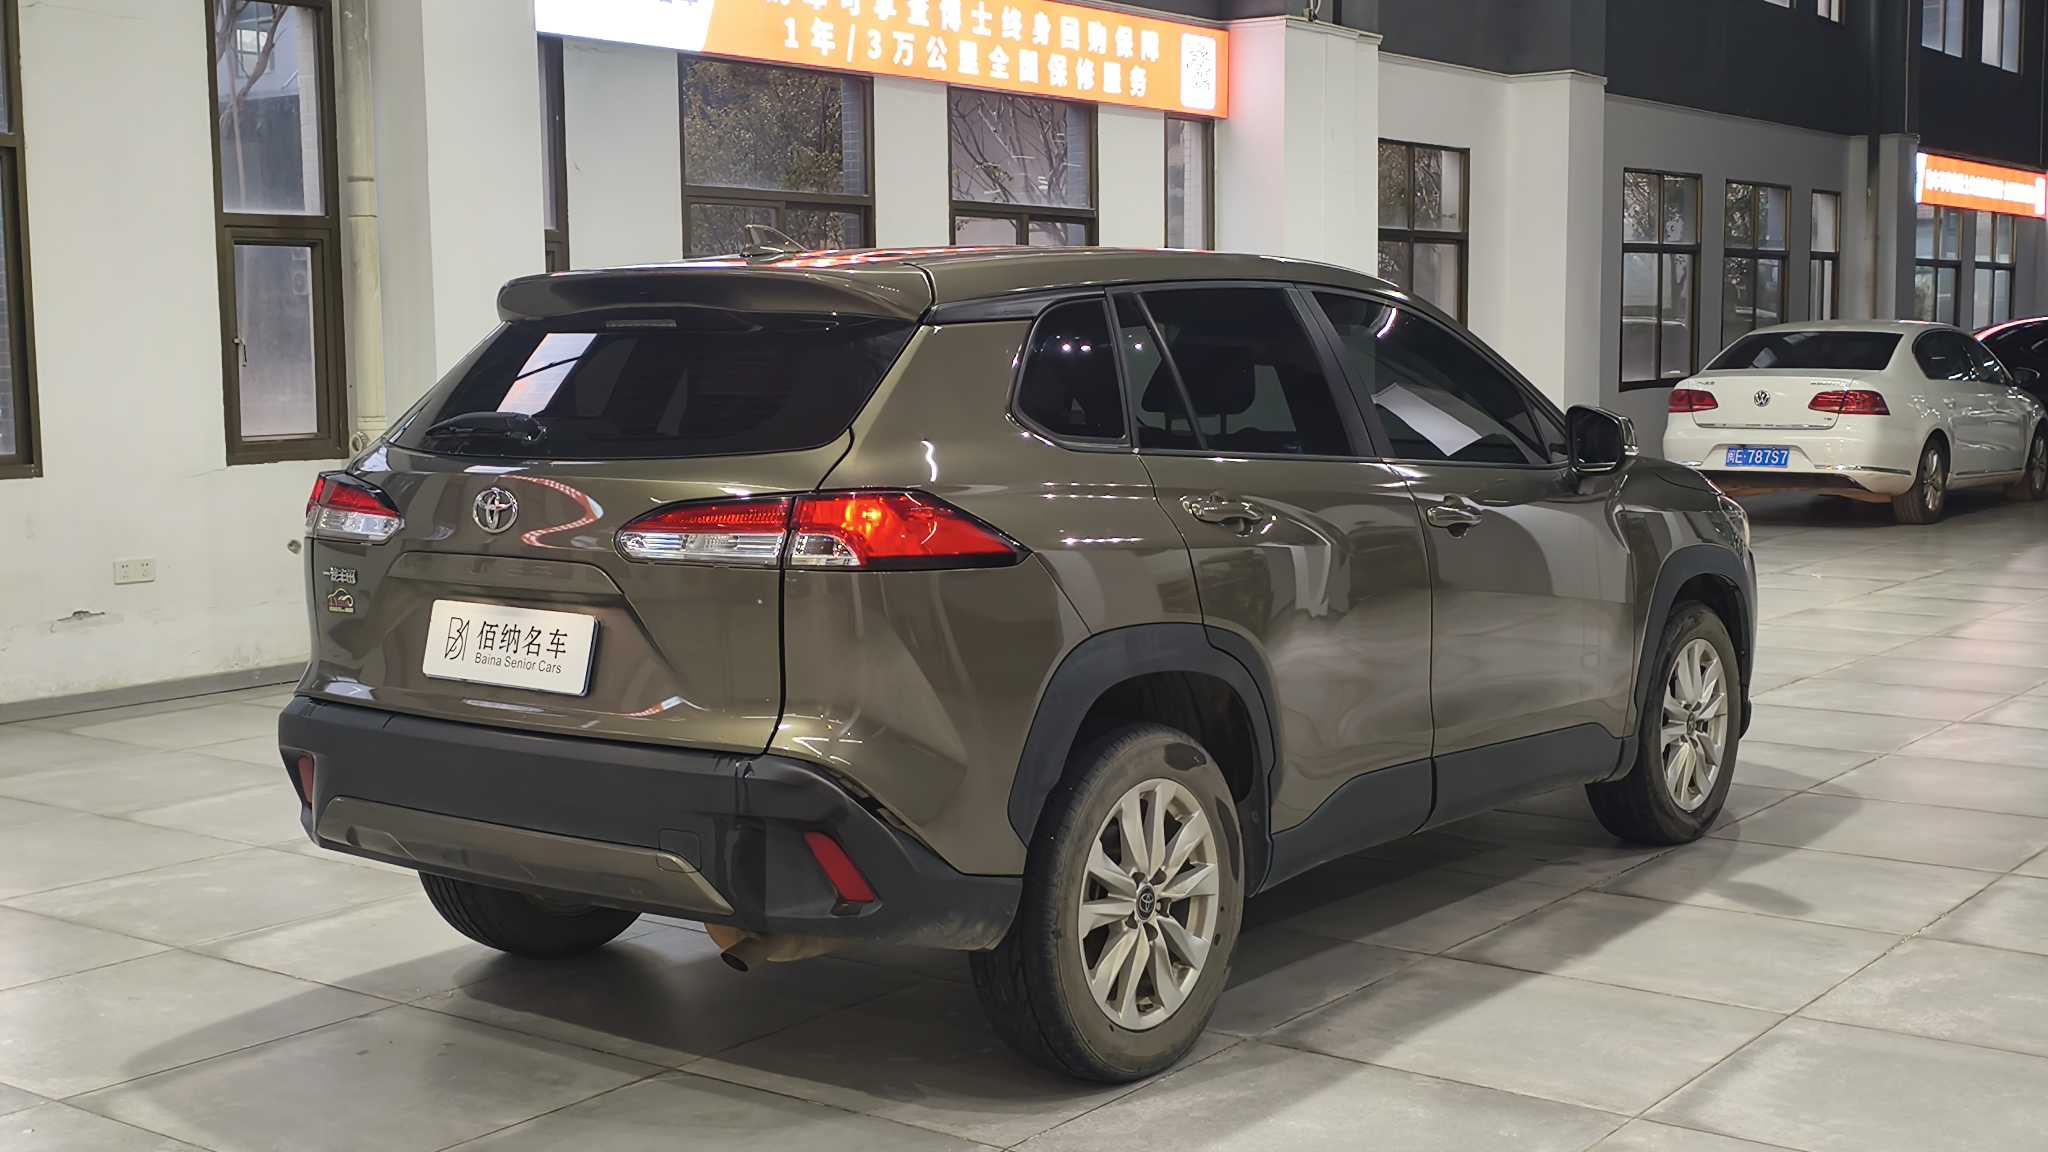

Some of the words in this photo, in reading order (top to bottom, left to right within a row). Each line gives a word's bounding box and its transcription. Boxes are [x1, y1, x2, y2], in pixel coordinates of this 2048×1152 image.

[768, 0, 1159, 62] 可享查博士终身回购保障
[477, 620, 568, 659] 佰纳名车
[474, 652, 502, 668] Baina
[504, 656, 536, 671] Senior
[538, 660, 562, 674] Cars
